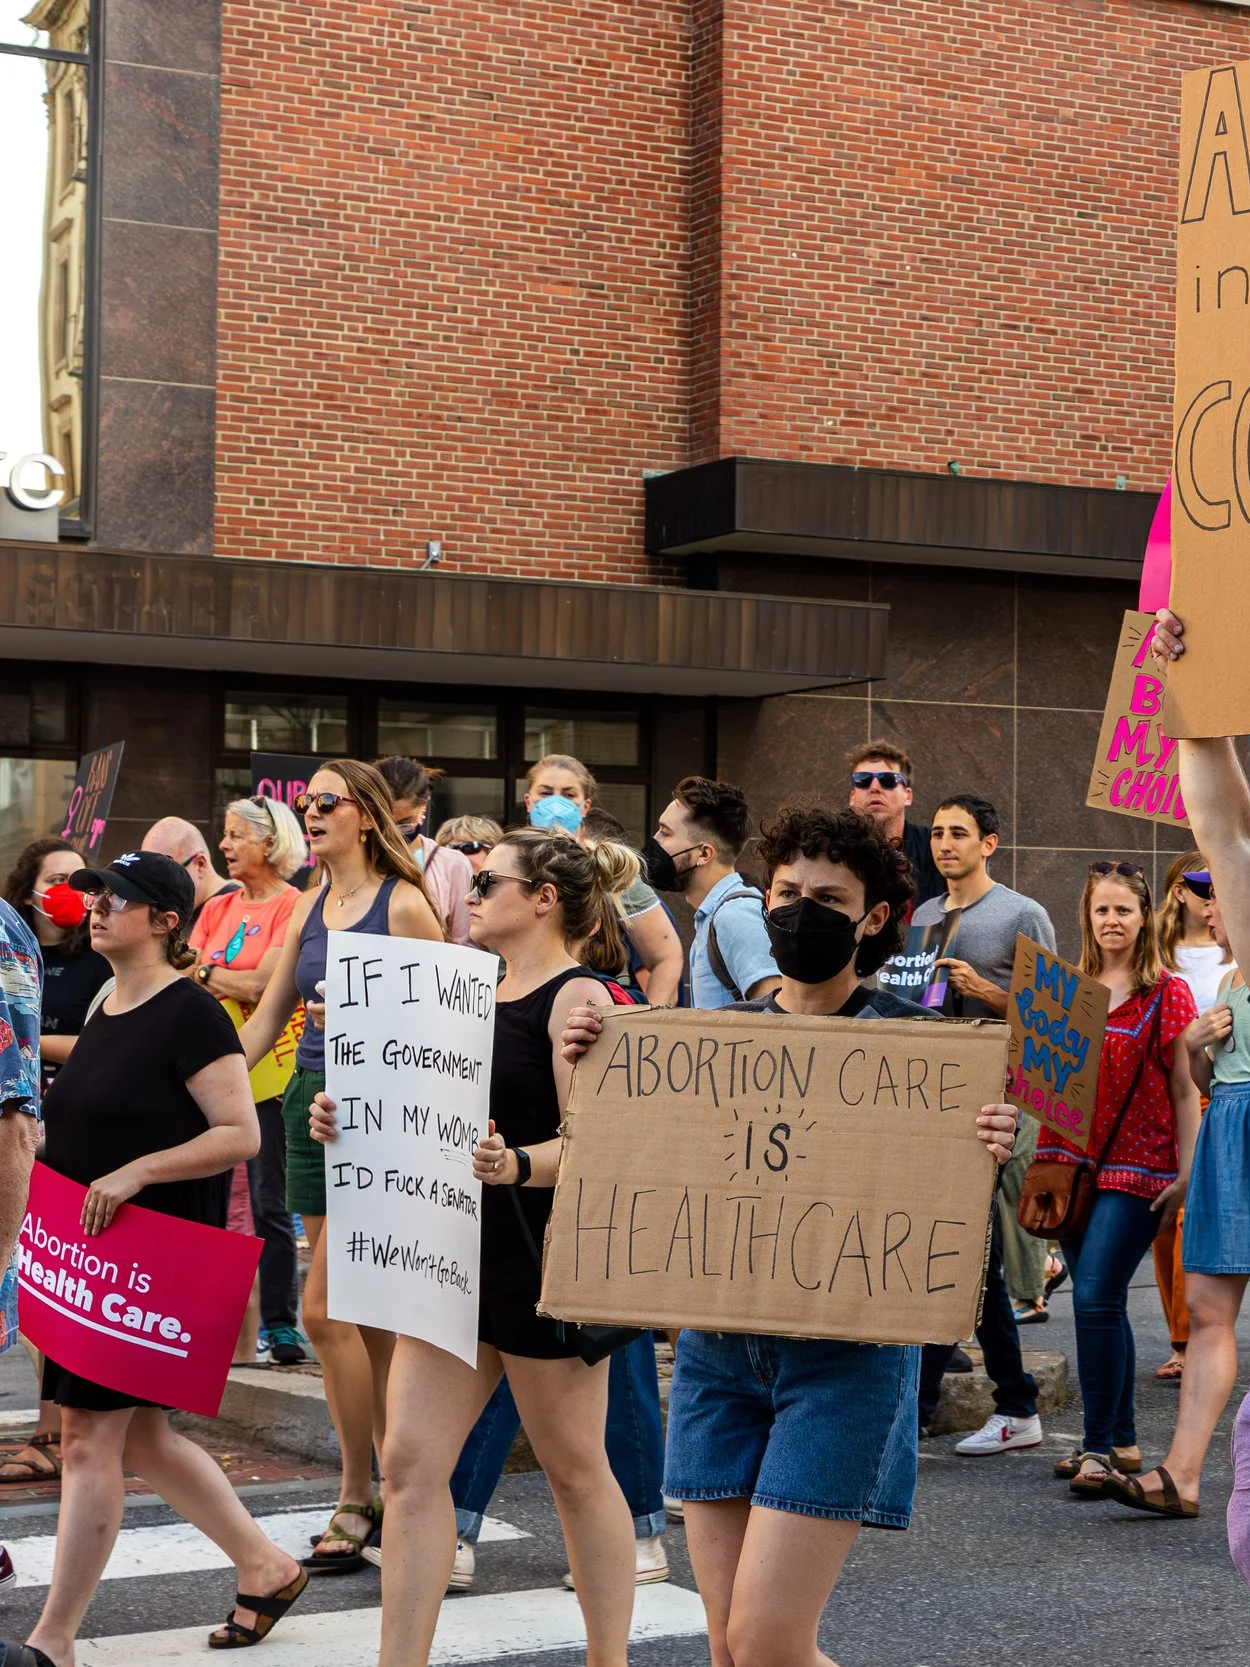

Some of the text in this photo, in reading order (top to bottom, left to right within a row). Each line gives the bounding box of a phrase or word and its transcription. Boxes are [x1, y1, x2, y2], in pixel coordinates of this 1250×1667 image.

[338, 956, 493, 1021] IF I WANTED
[879, 971, 922, 987] ealth
[1035, 952, 1081, 1011] MY
[329, 1033, 483, 1085] THE GOVERNMENT
[1015, 987, 1091, 1073] body
[596, 1032, 967, 1112] ABORTION CARE
[1022, 1036, 1072, 1094] MY
[341, 1097, 479, 1157] IN MY WOMB
[745, 1120, 791, 1172] IS
[332, 1162, 478, 1222] I'D FUCK A SENATOR
[19, 1212, 152, 1293] Abortion is
[575, 1177, 967, 1297] HEALTHCARE
[18, 1243, 192, 1344] Health Care.
